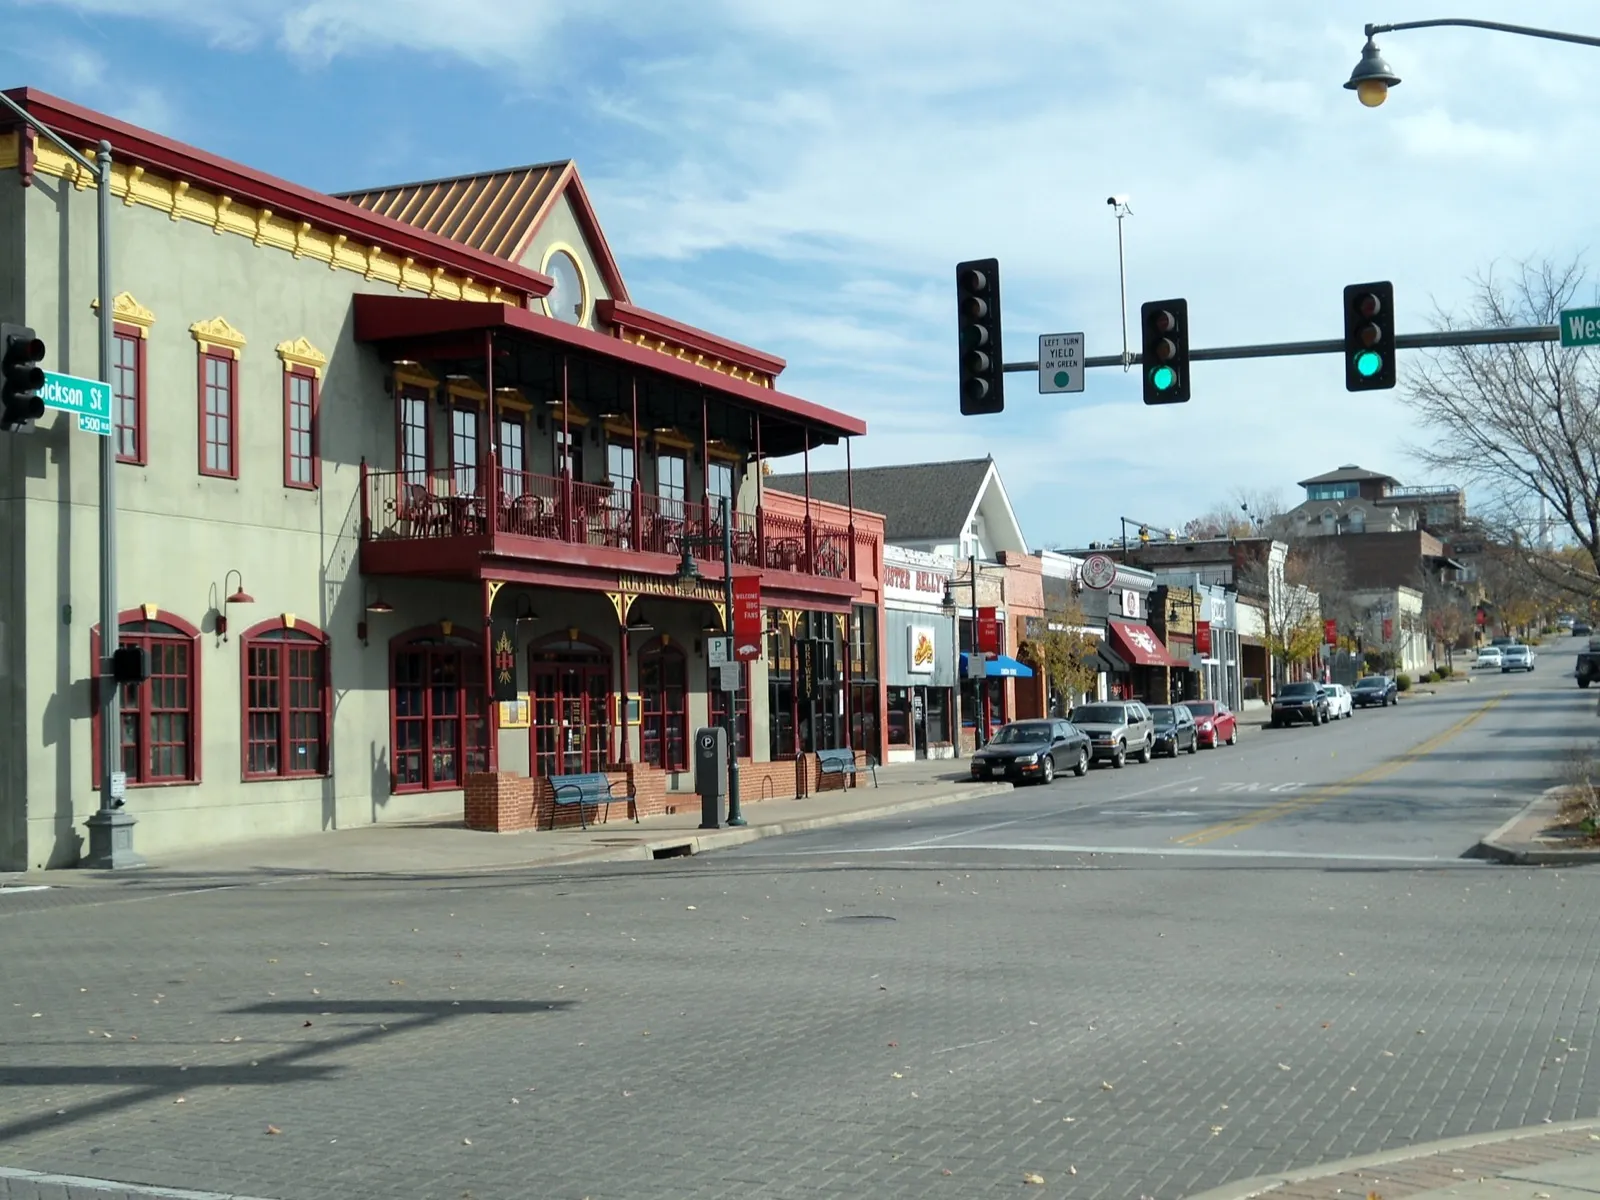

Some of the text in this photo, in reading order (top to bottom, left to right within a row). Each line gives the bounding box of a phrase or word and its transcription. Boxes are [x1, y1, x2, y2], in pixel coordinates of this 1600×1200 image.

[1044, 337, 1079, 347] LEFT TURN
[1050, 348, 1074, 358] YIELD
[1046, 360, 1078, 369] ON GREEN
[90, 387, 102, 411] St
[85, 415, 100, 431] 500
[674, 579, 720, 601] BWING
[715, 641, 721, 651] P
[804, 643, 812, 698] BREWERY
